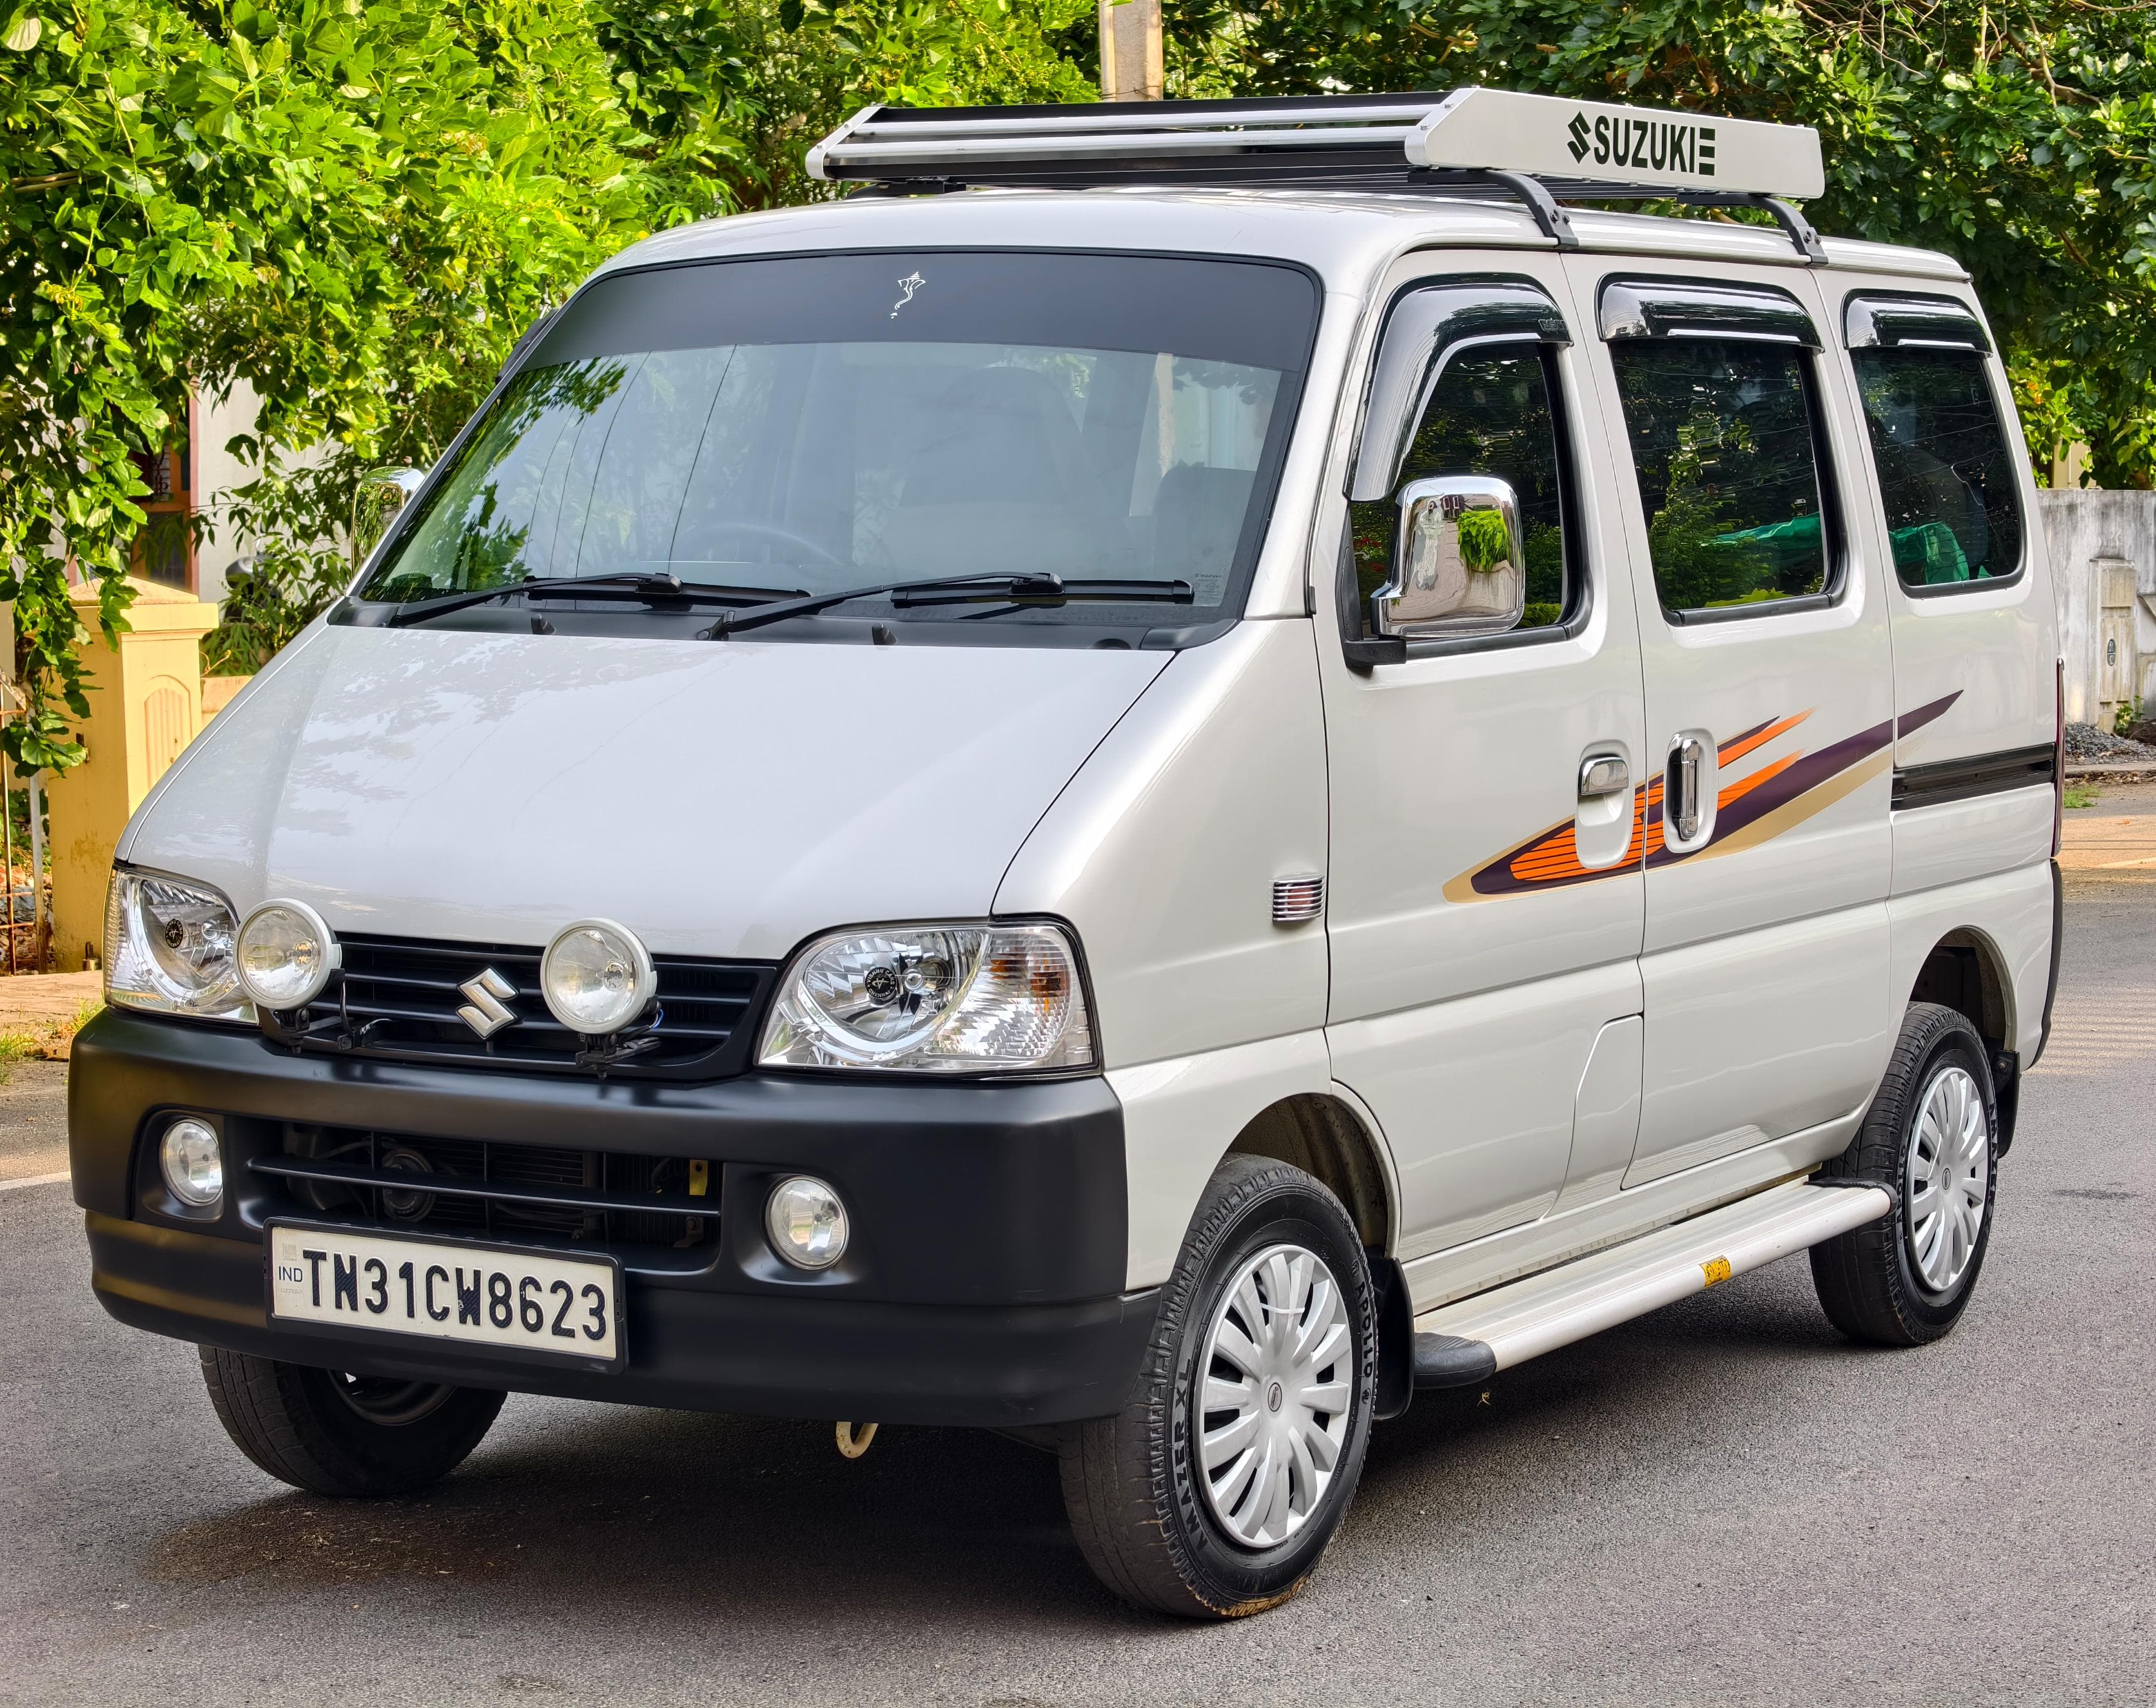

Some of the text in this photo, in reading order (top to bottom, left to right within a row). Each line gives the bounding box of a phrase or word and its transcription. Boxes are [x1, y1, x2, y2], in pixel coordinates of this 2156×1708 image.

[867, 969, 895, 985] VISHNU CARS
[868, 988, 891, 998] CHENNAI
[279, 1265, 303, 1283] IND
[302, 1249, 607, 1341] TN31CW8623
[1355, 1280, 1373, 1378] APOLLO
